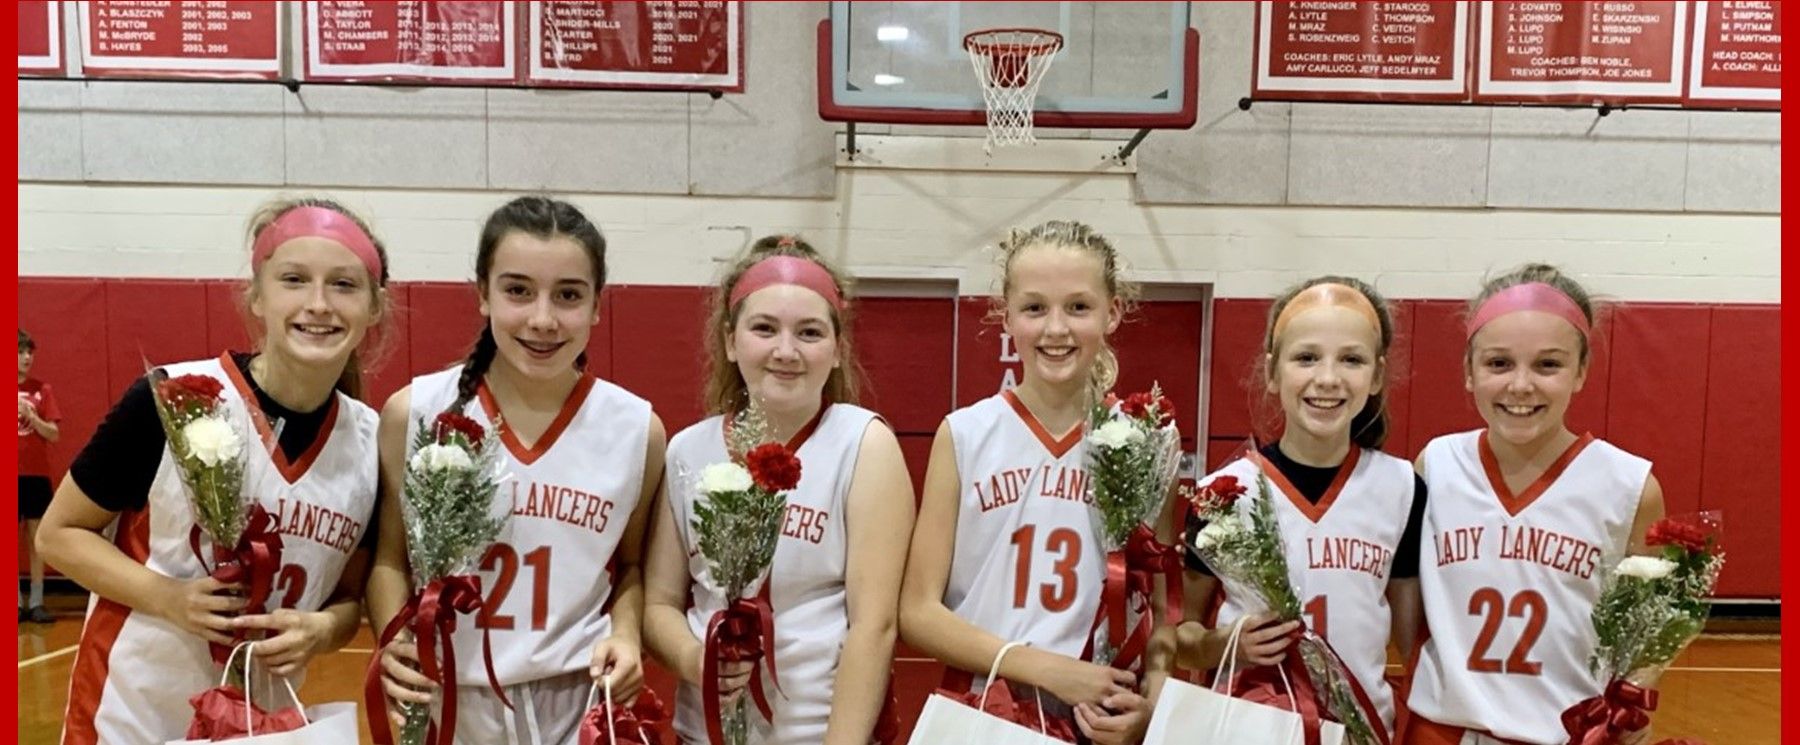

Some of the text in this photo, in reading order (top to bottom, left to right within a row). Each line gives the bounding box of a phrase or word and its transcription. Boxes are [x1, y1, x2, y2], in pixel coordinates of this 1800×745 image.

[1384, 14, 1436, 23] THOMPSON
[1520, 14, 1563, 22] JOHNSON
[1733, 11, 1774, 20] SIMPSON
[111, 20, 148, 29] FENTON
[336, 21, 372, 29] TAYLOR
[1300, 23, 1326, 31] MRAZ
[1519, 24, 1544, 33] LUPO
[1734, 23, 1772, 31] PUTNAM
[1519, 35, 1544, 44] LUPO
[111, 42, 142, 51] HAYES
[1519, 46, 1544, 55] LUPO
[1333, 53, 1355, 62] ERIC
[1387, 54, 1413, 63] ANDY
[1415, 55, 1441, 64] MRAZ
[1713, 51, 1738, 60] HEAD
[1580, 57, 1599, 65] BEN
[1286, 64, 1306, 73] AMY
[1359, 65, 1380, 74] JEFF
[1510, 68, 1546, 77] TREVOR
[1602, 68, 1620, 77] JOE
[1622, 69, 1652, 77] JONES
[974, 468, 1031, 512] LADY
[512, 481, 614, 533] LANCERS
[277, 499, 361, 554] LANCERS
[1434, 525, 1600, 579] LADY LANCERS
[1307, 537, 1391, 579] LANCERS
[1010, 524, 1083, 613] 13
[475, 542, 552, 631] 21
[1467, 587, 1548, 675] 22
